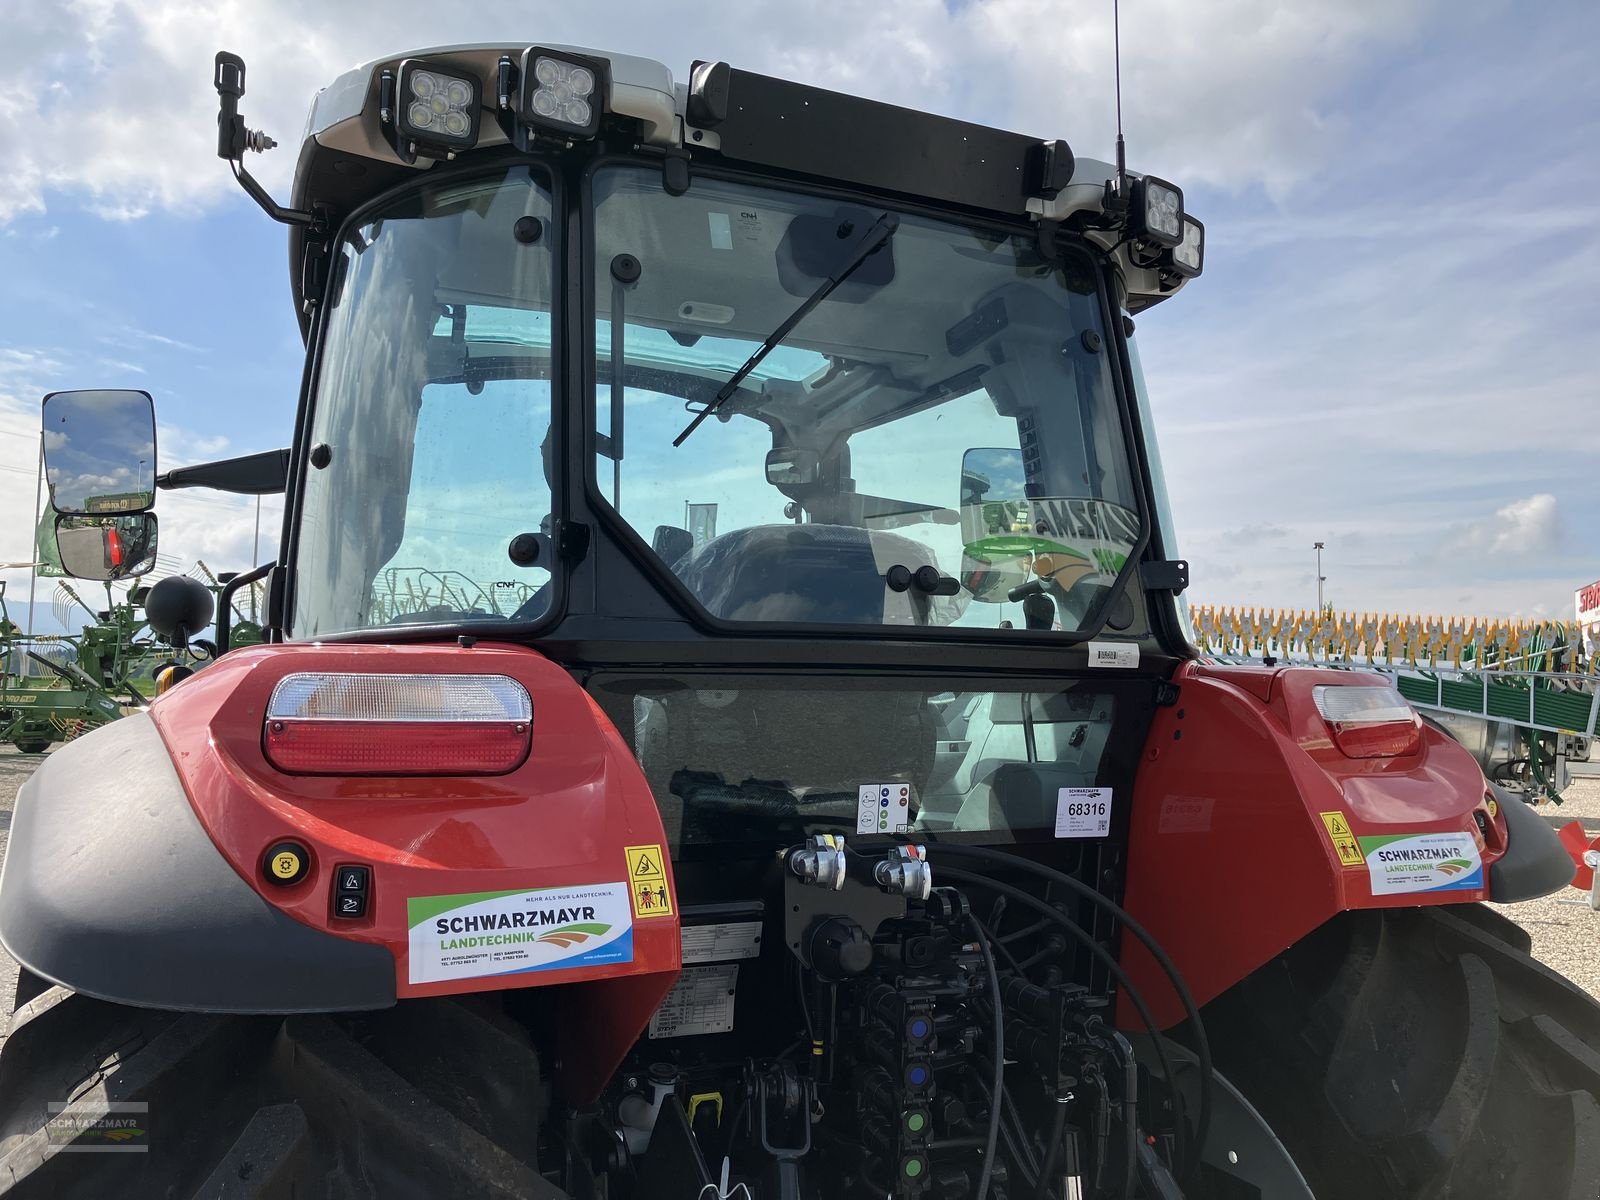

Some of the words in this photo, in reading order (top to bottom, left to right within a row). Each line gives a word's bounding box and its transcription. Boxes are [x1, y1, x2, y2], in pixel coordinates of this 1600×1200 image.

[496, 579, 516, 588] CNH
[1068, 803, 1106, 816] 68316
[1378, 847, 1463, 862] SCHWARZMAYR
[1384, 863, 1435, 873] LANDTECHNIK
[436, 906, 595, 935] SCHWARZMAYR
[440, 931, 535, 950] LANDTECHNIK
